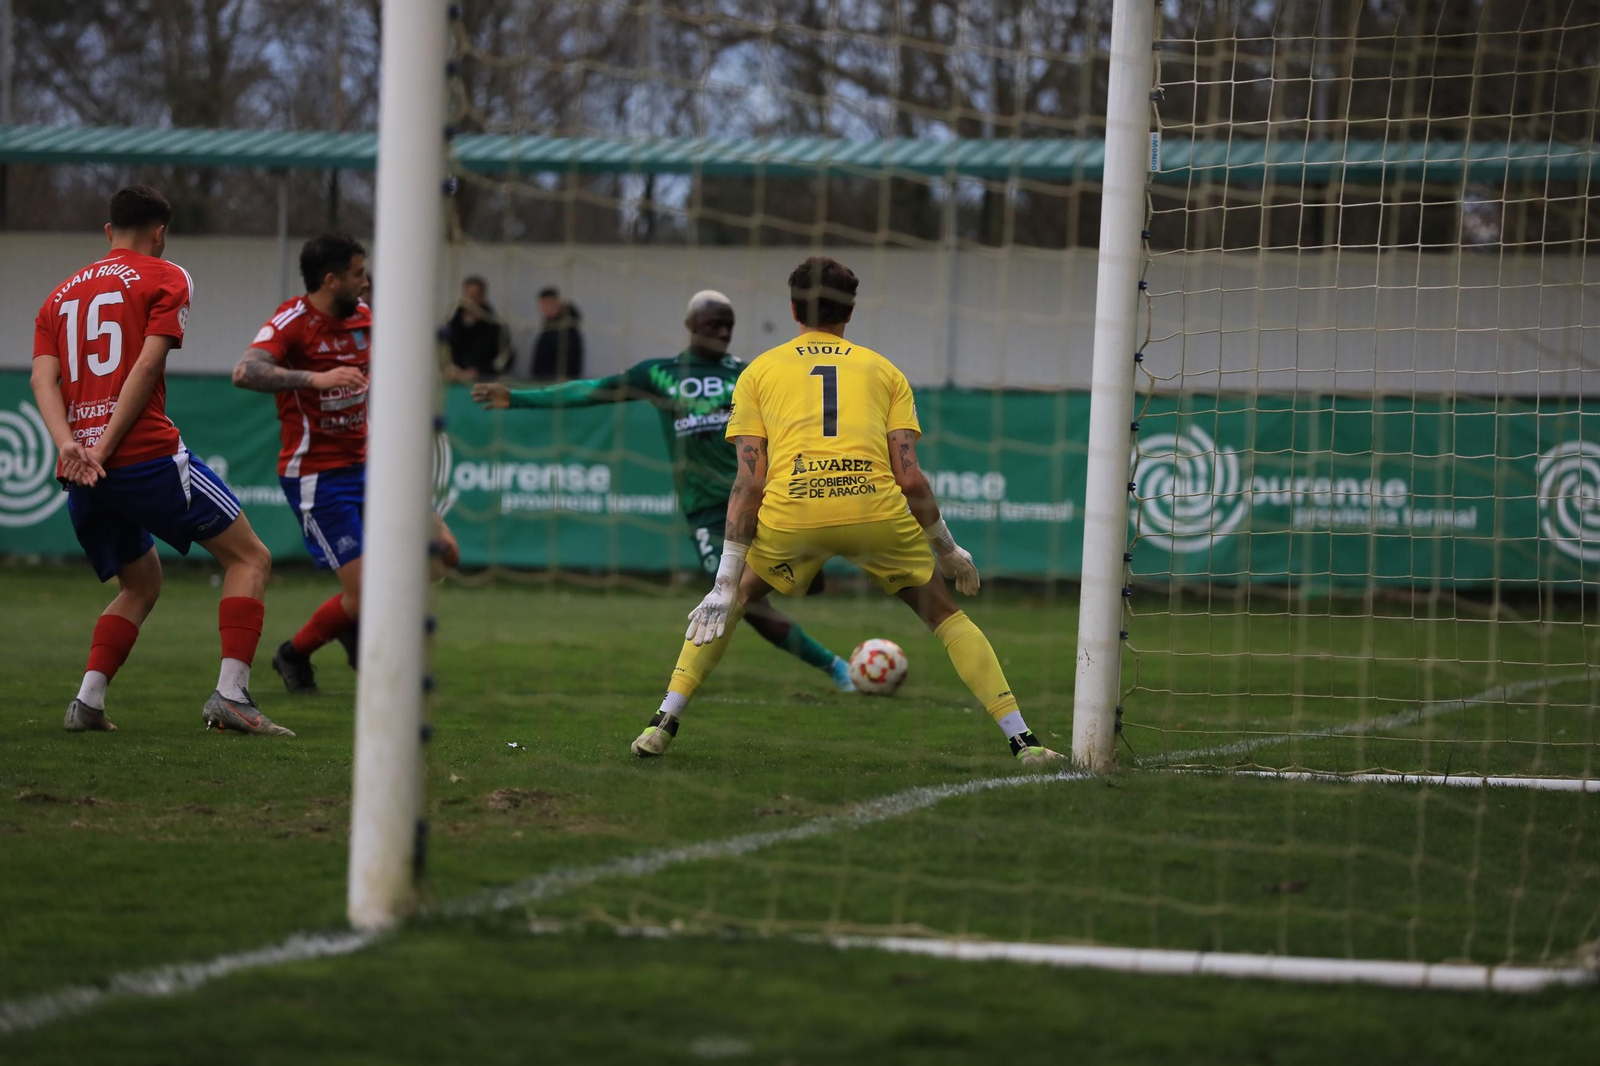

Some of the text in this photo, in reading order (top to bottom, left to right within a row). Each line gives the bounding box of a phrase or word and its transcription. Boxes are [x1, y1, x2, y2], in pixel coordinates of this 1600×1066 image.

[54, 269, 94, 303] JUAN
[58, 290, 125, 383] 15
[795, 345, 852, 356] FUOLI
[809, 365, 838, 438] 1
[809, 476, 867, 488] GOBIERNO
[809, 489, 825, 498] DE
